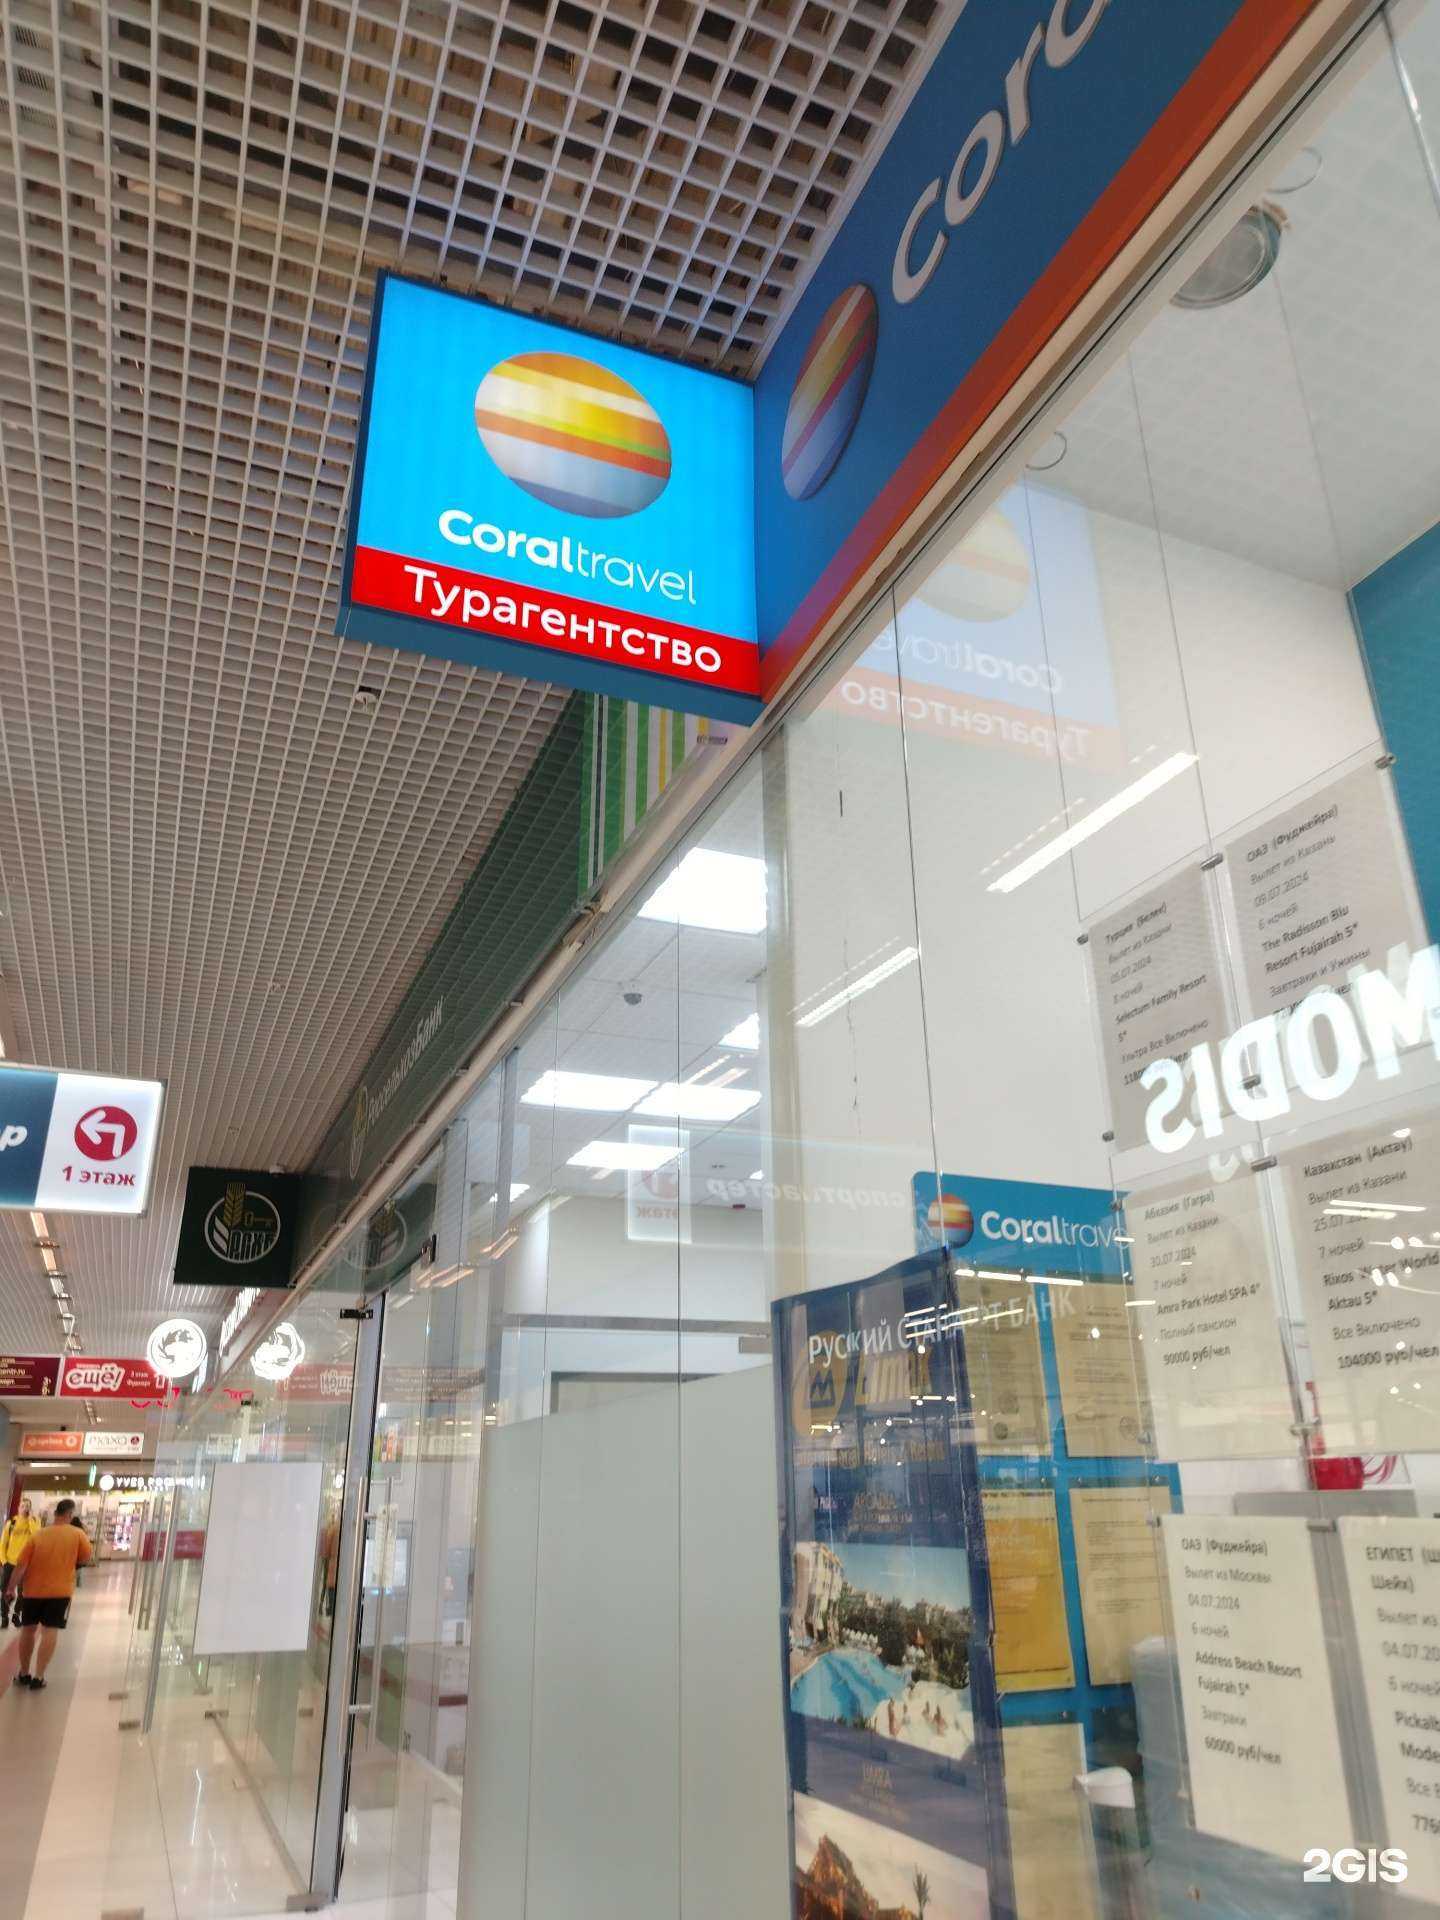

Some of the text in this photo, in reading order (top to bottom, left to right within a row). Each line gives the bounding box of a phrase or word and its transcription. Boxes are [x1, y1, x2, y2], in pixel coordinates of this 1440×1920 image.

[438, 509, 698, 606] Coraltravel
[404, 564, 722, 674] Турагентство
[1262, 938, 1281, 951] The
[1265, 952, 1298, 976] Resort
[62, 1165, 135, 1187] 1 этаж
[1303, 1153, 1362, 1178] Казахстан
[1322, 1271, 1354, 1287] Rixos
[1397, 1250, 1440, 1269] World
[1156, 1302, 1180, 1316] Amra
[1181, 1297, 1202, 1310] Park
[1229, 1285, 1249, 1300] SPA
[1328, 1295, 1362, 1311] Aktau
[1366, 1546, 1414, 1562] ЕГИПЕТ
[1195, 1650, 1303, 1680] Address Beach Resort
[1198, 1675, 1237, 1695] Fujairah
